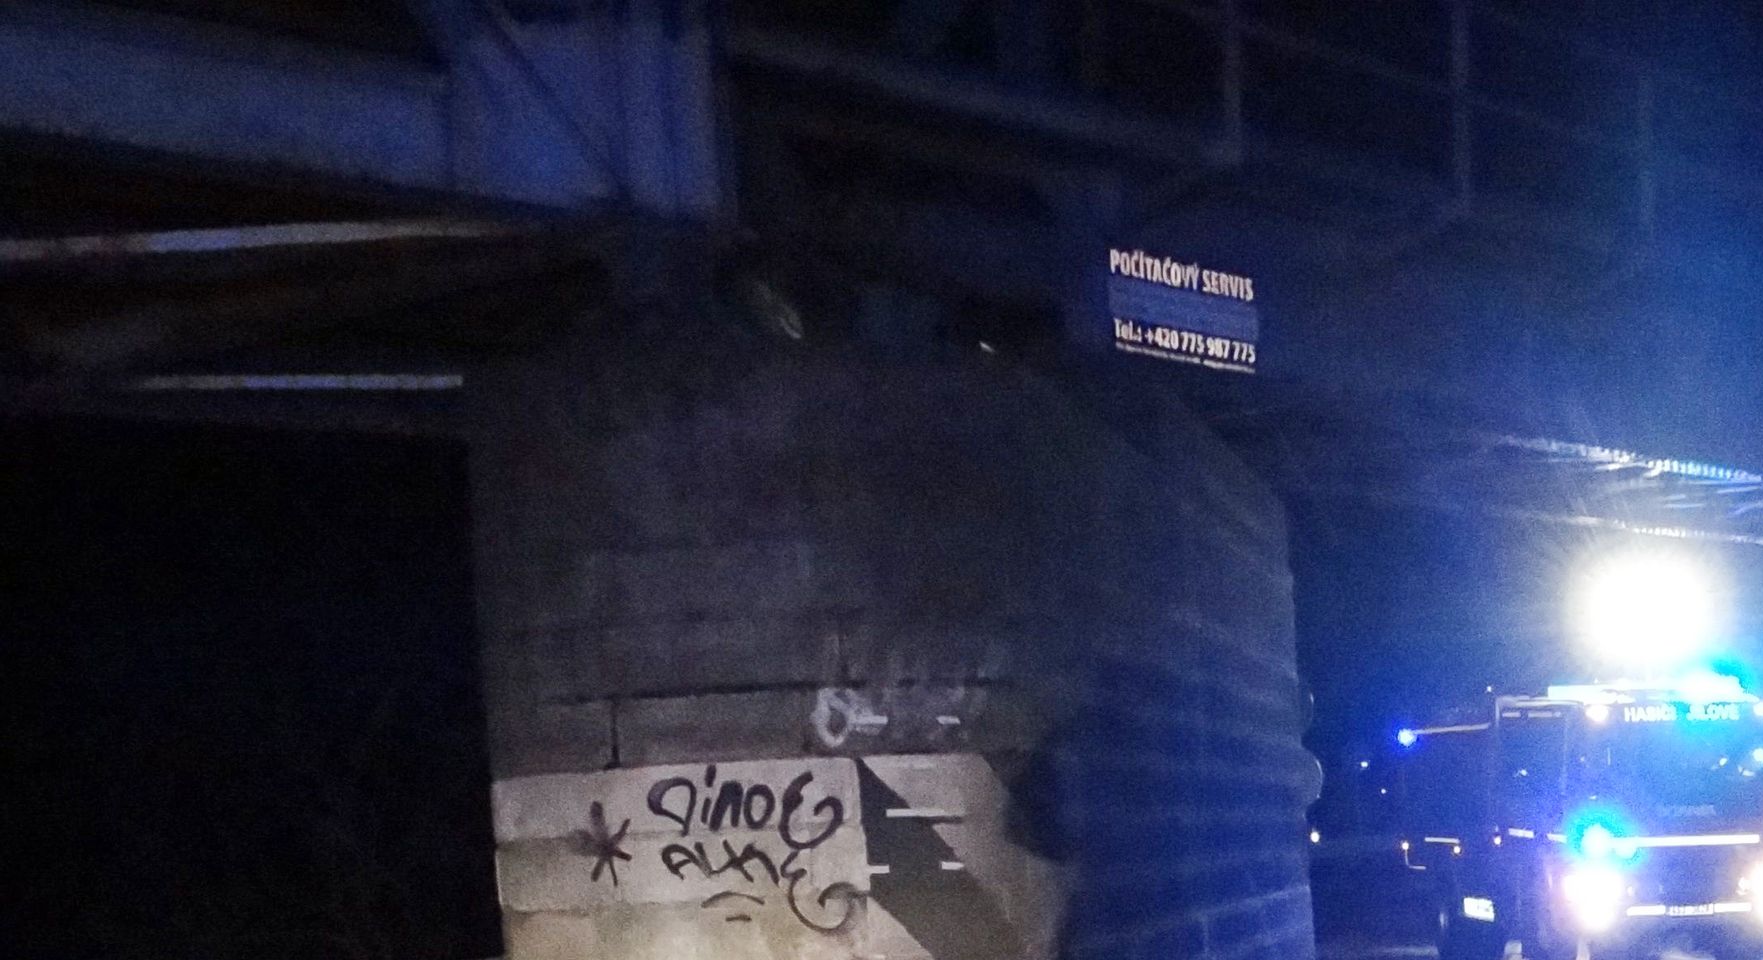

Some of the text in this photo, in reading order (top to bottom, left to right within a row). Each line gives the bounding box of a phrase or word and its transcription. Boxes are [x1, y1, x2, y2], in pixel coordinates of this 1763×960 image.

[1109, 248, 1254, 302] POČÍTAČOVÝ SERVIS
[1145, 327, 1179, 350] +420
[1180, 331, 1205, 354] 775
[1206, 337, 1231, 359] 987
[1232, 341, 1256, 363] 775
